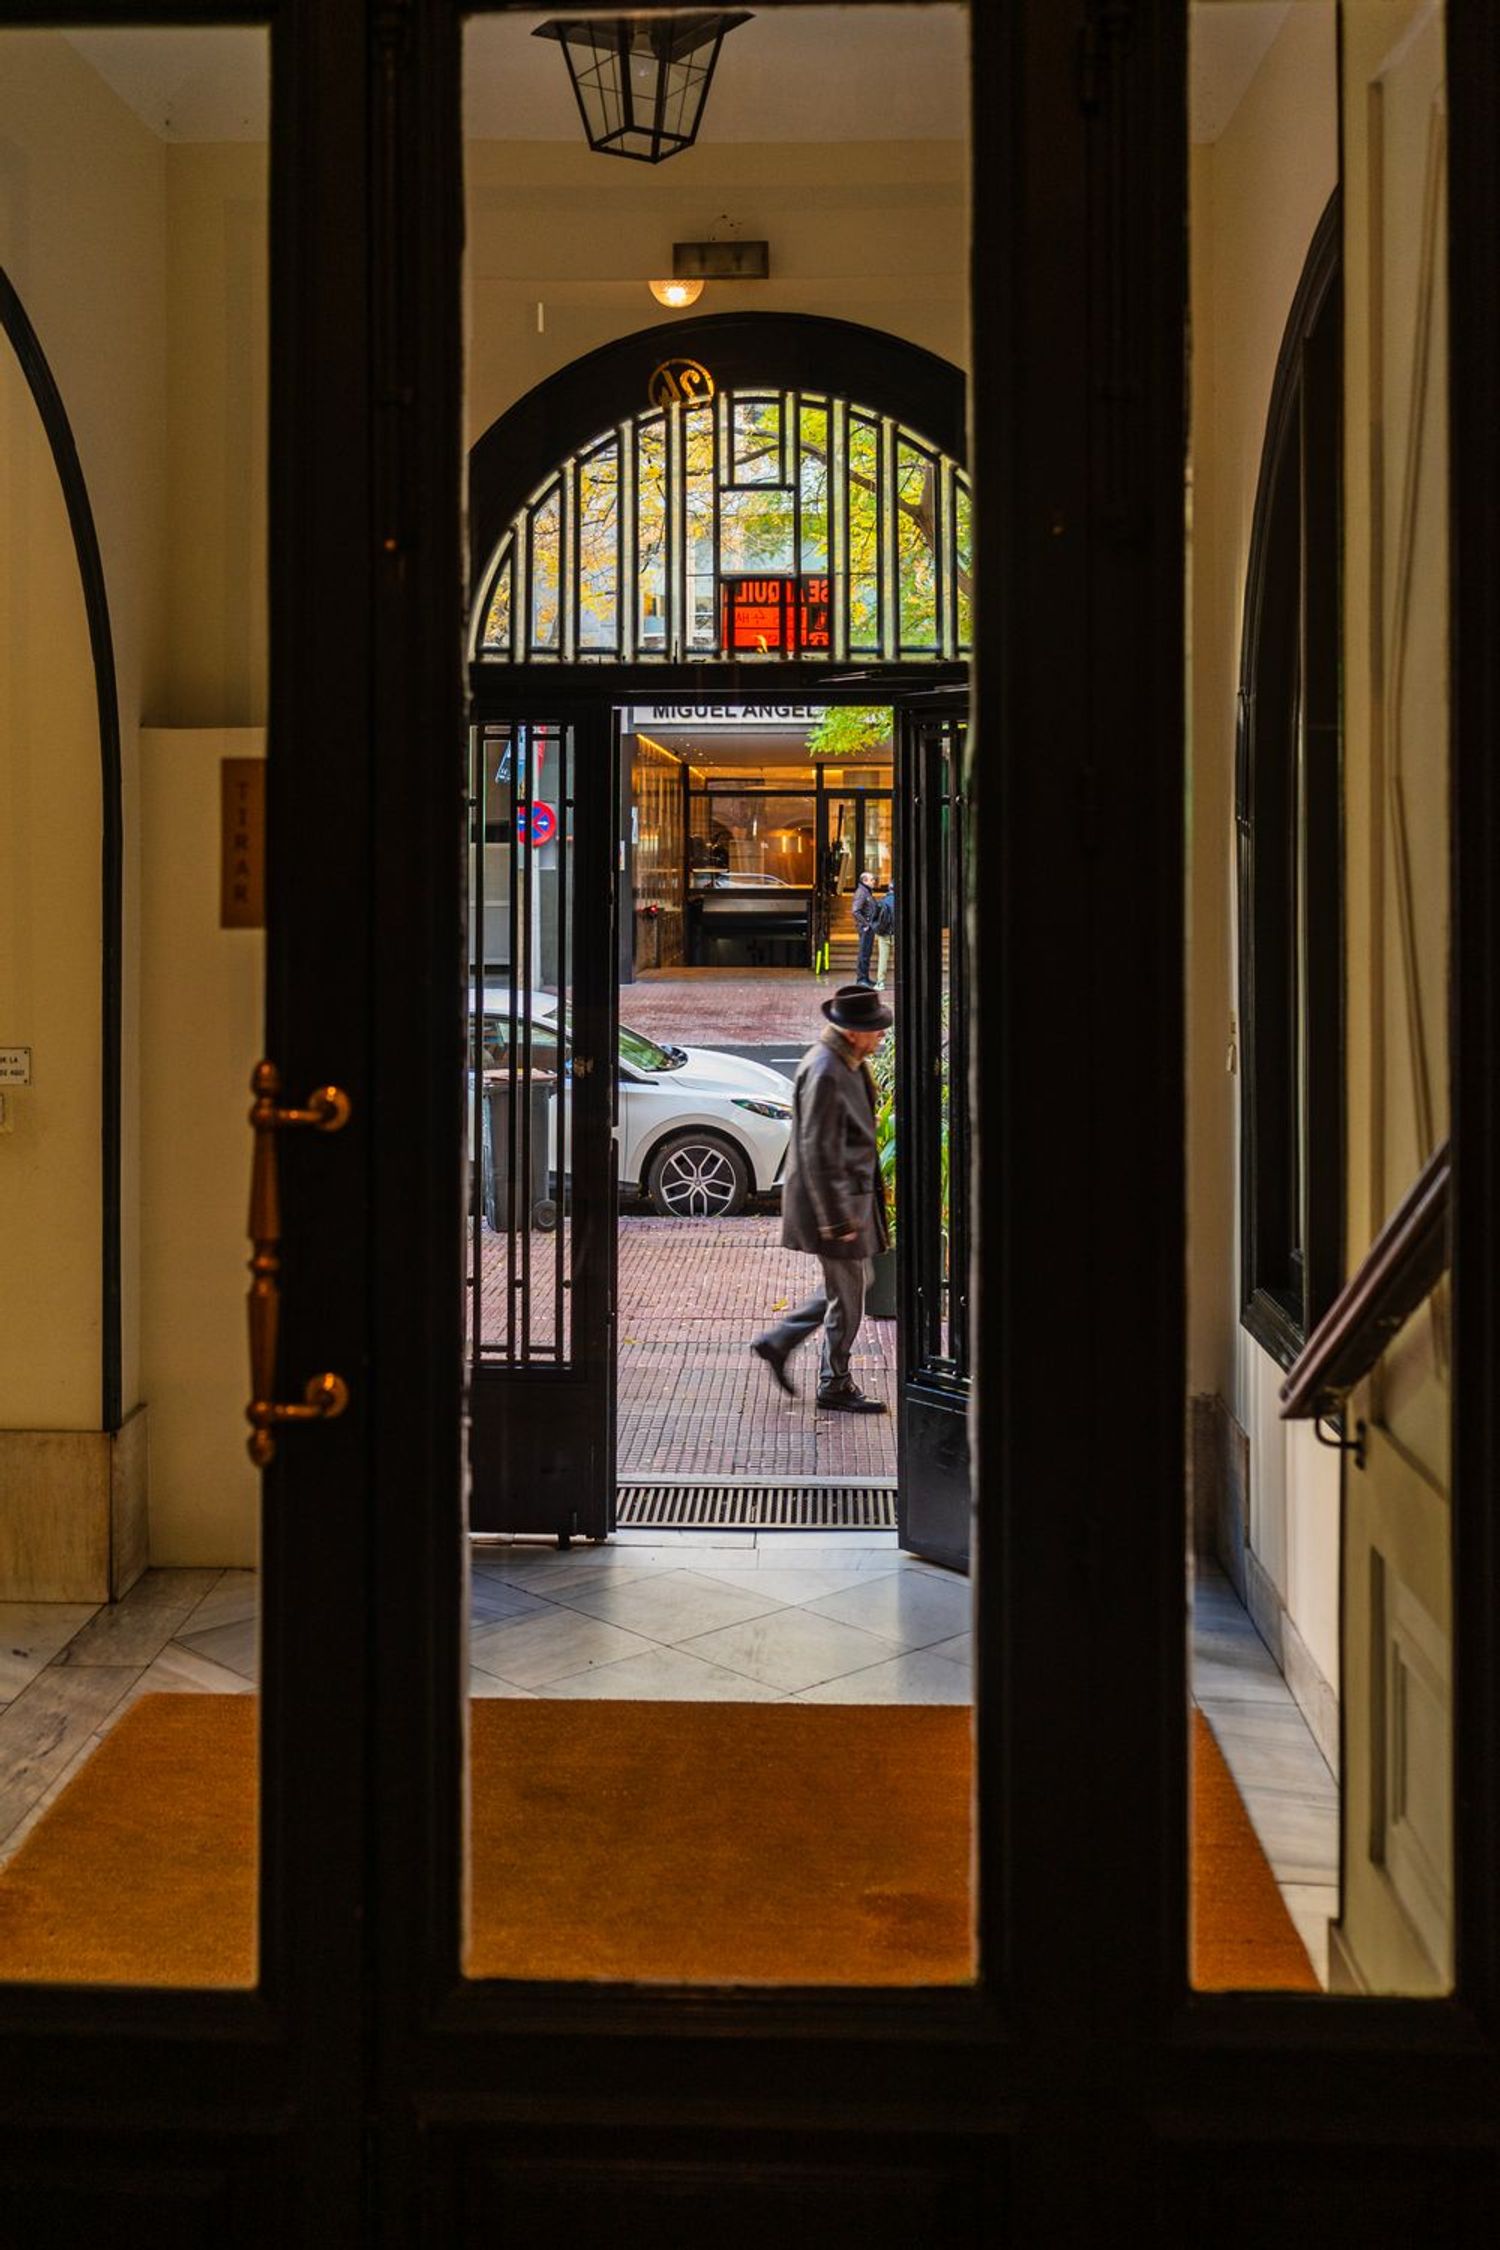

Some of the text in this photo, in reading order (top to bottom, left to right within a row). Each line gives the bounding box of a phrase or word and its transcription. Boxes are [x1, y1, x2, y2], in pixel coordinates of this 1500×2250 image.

[652, 705, 820, 719] MIGUEL ANGEL
[233, 781, 250, 904] TIRAR
